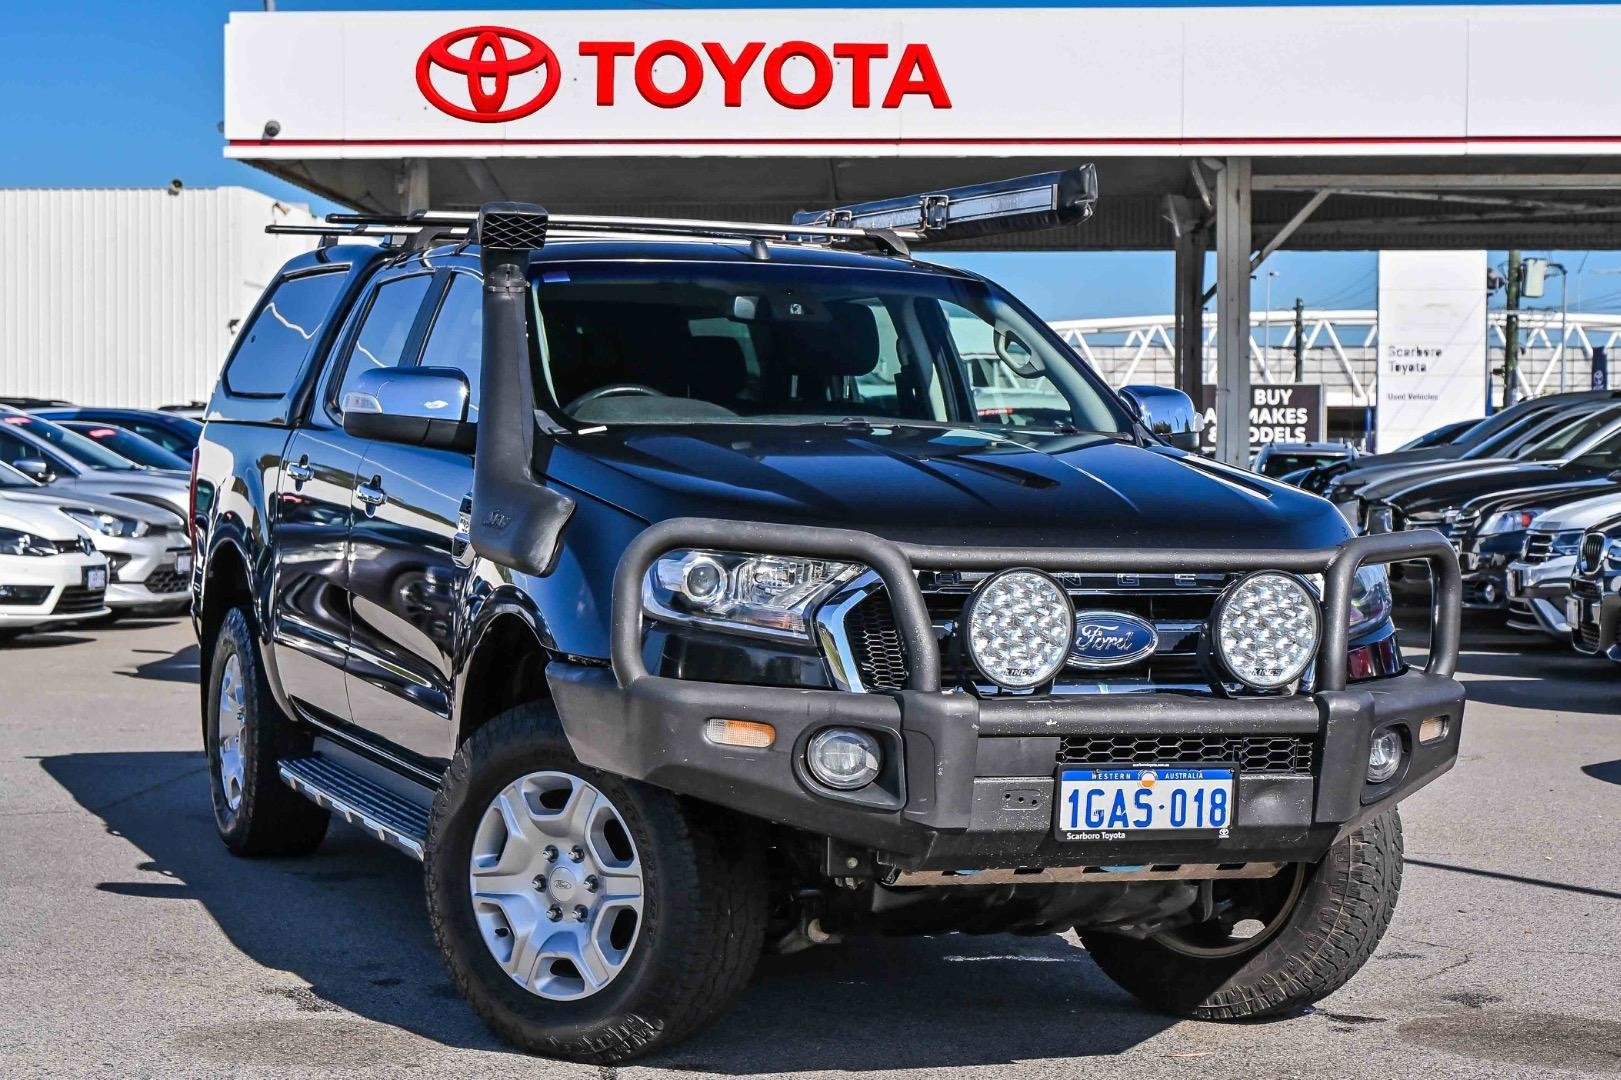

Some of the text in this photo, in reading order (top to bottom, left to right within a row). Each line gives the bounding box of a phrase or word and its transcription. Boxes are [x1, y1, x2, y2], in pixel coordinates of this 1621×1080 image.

[579, 40, 952, 110] TOYOTA
[1388, 361, 1427, 375] Toyota
[1254, 389, 1293, 405] BUY
[1249, 427, 1306, 443] ODELS
[1076, 625, 1134, 650] Ford
[1165, 772, 1203, 780] AUSTRALIA
[1067, 831, 1126, 841] Scarboro Toyota
